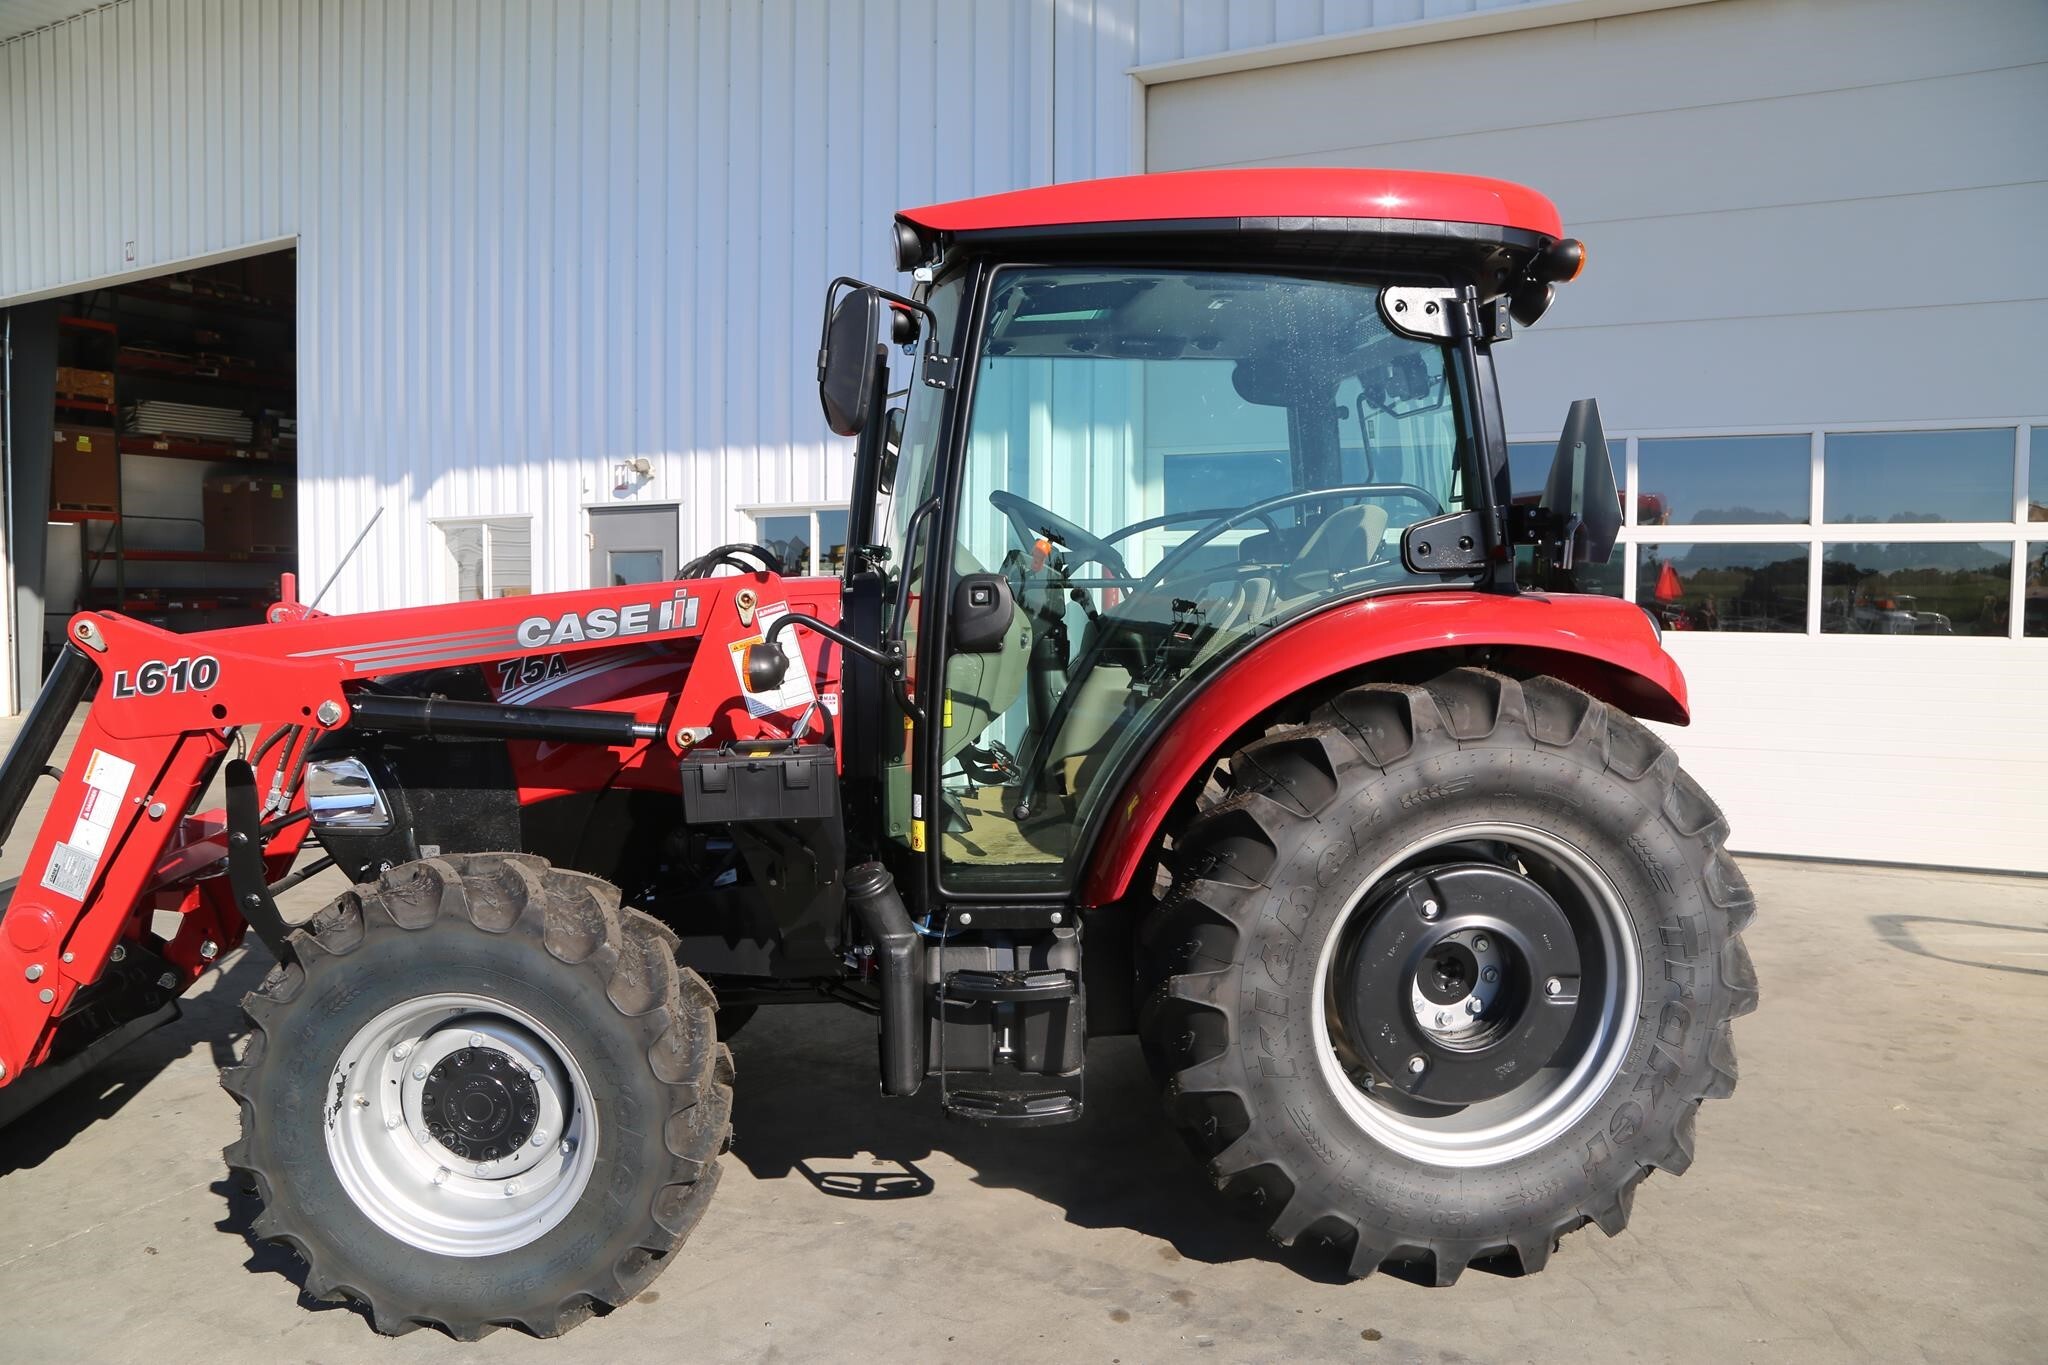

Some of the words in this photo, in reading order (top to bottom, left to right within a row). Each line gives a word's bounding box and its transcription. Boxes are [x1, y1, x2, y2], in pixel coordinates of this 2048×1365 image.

[517, 603, 651, 648] CASE
[113, 655, 220, 699] L610
[498, 652, 569, 694] 75A
